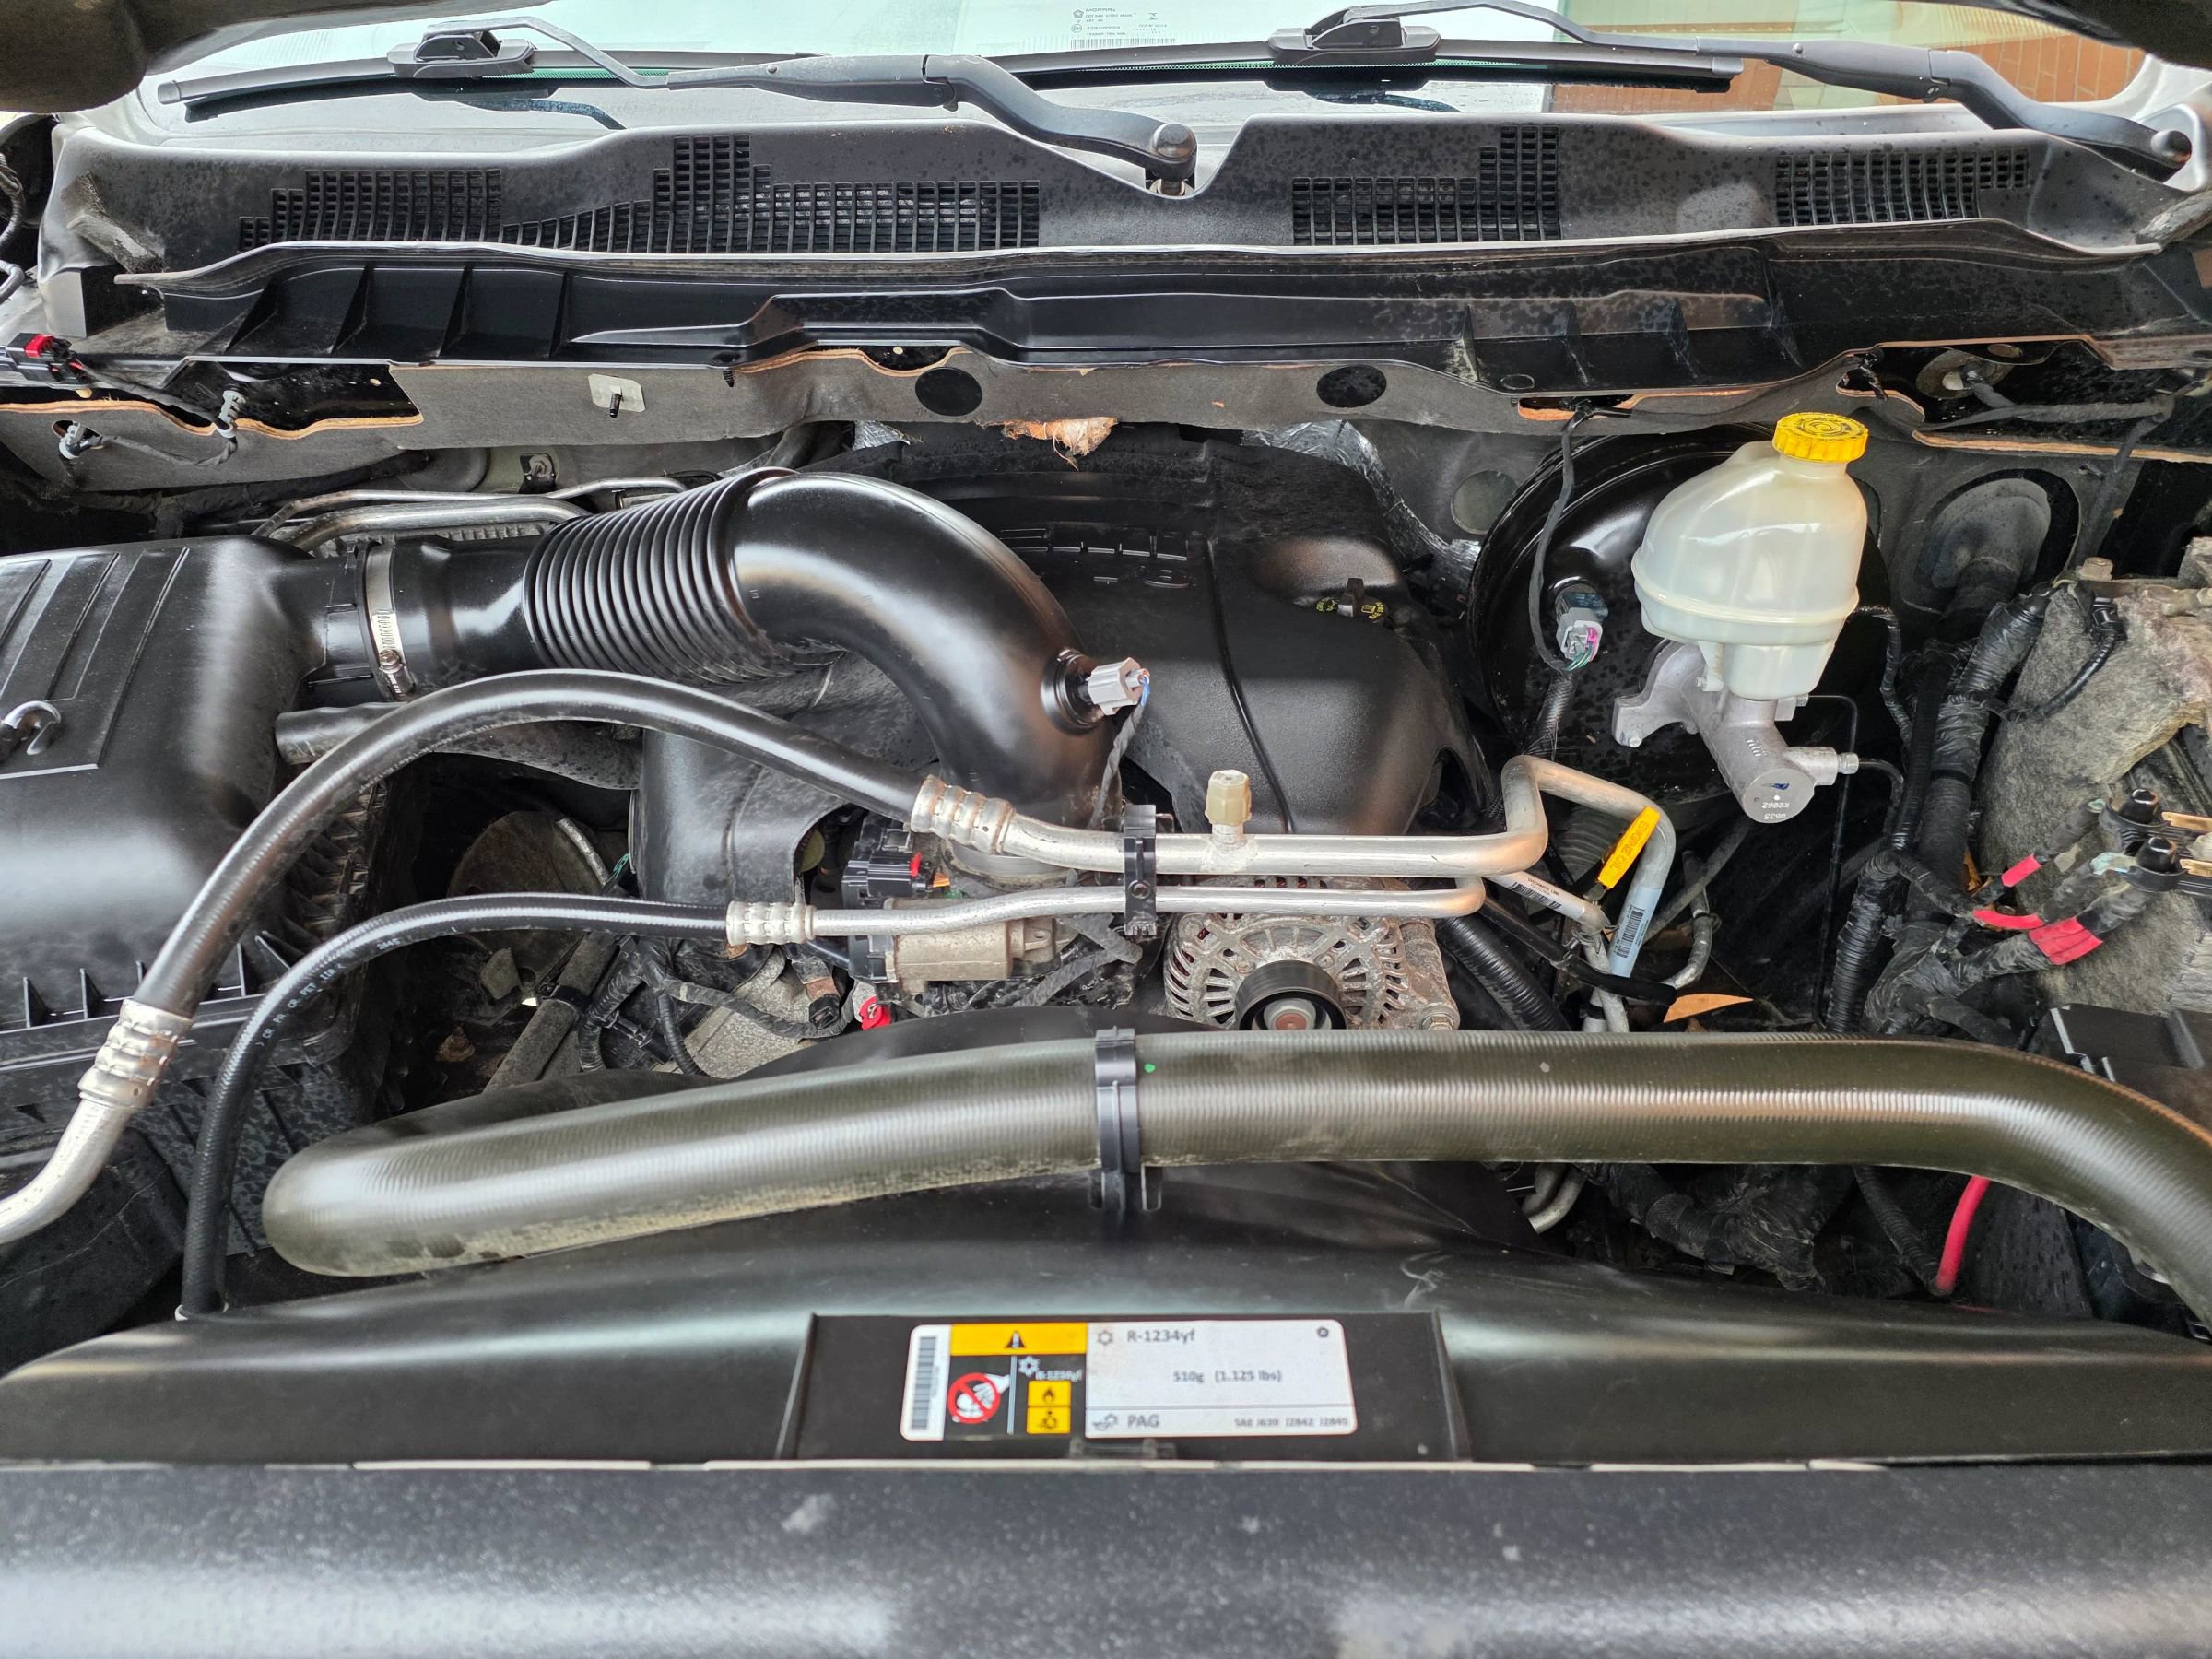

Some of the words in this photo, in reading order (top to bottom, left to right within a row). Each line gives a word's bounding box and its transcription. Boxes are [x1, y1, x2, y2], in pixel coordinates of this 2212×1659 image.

[1621, 820, 1650, 856] ENGINE
[1609, 853, 1626, 870] OIL
[300, 982, 318, 996] PET
[1127, 1328, 1195, 1344] R-1234yf
[1172, 1370, 1205, 1383] 510g
[1214, 1369, 1255, 1383] (1.125
[1257, 1369, 1282, 1383] lbs)
[1127, 1413, 1160, 1429] PAG
